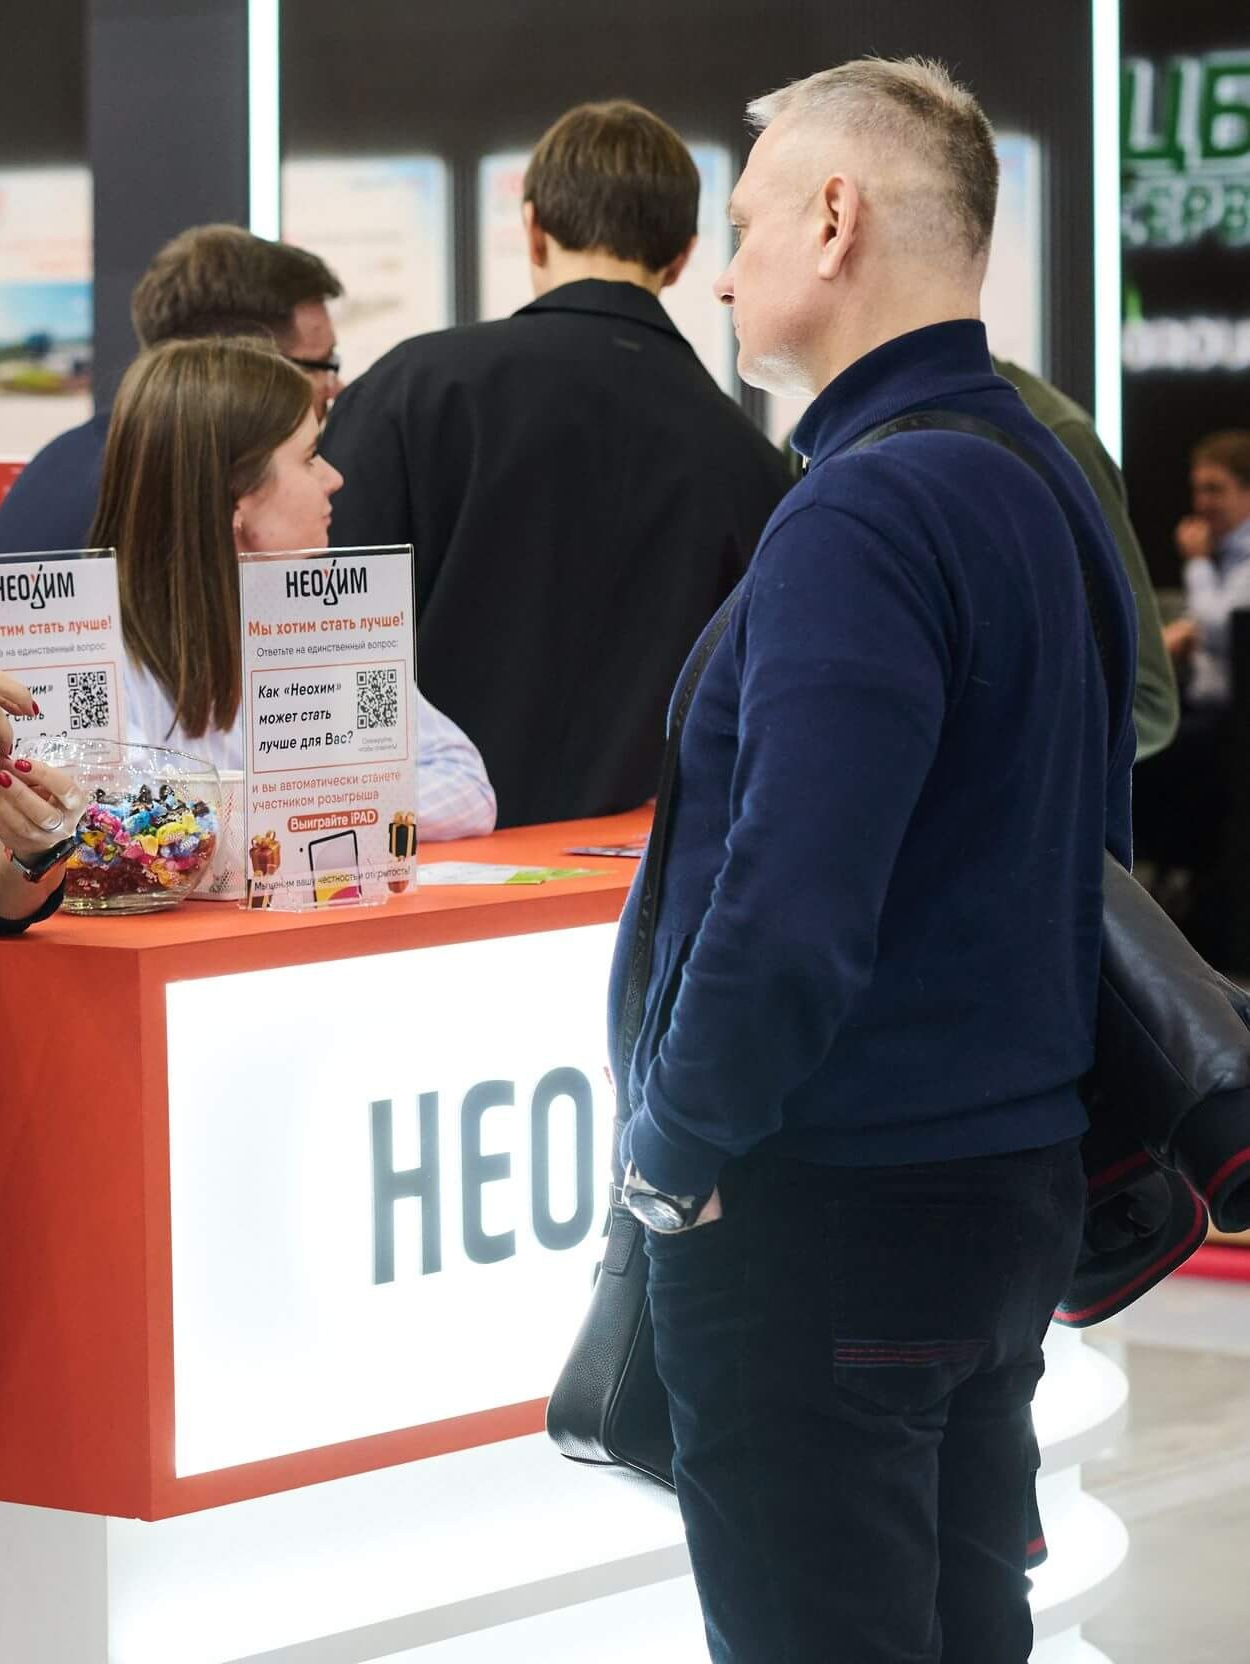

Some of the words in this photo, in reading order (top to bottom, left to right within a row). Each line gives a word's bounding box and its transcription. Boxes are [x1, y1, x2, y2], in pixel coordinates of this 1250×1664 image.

[286, 559, 368, 605] НЕОХИМ
[29, 620, 64, 635] стать
[69, 615, 112, 636] лучше!
[249, 621, 272, 636] Мы
[277, 621, 316, 635] хотим
[321, 618, 356, 631] стать
[360, 612, 404, 632] лучше!
[17, 644, 74, 657] единственный
[256, 646, 294, 657] Ответьте
[307, 642, 366, 655] единственный
[258, 685, 279, 699] Как
[284, 682, 341, 697] «Неохим»
[259, 711, 298, 725] может
[301, 709, 332, 722] стать
[258, 737, 297, 754] лучше
[300, 736, 322, 749] для
[325, 730, 354, 746] Вас?
[252, 785, 259, 794] и
[262, 783, 277, 793] вы
[280, 774, 358, 792] автоматически
[362, 771, 401, 785] станете
[252, 795, 315, 813] участником
[317, 789, 379, 808] розыгрыша
[290, 814, 348, 831] Выиграйте
[350, 810, 377, 824] iPAD
[369, 1065, 616, 1289] НЕО
